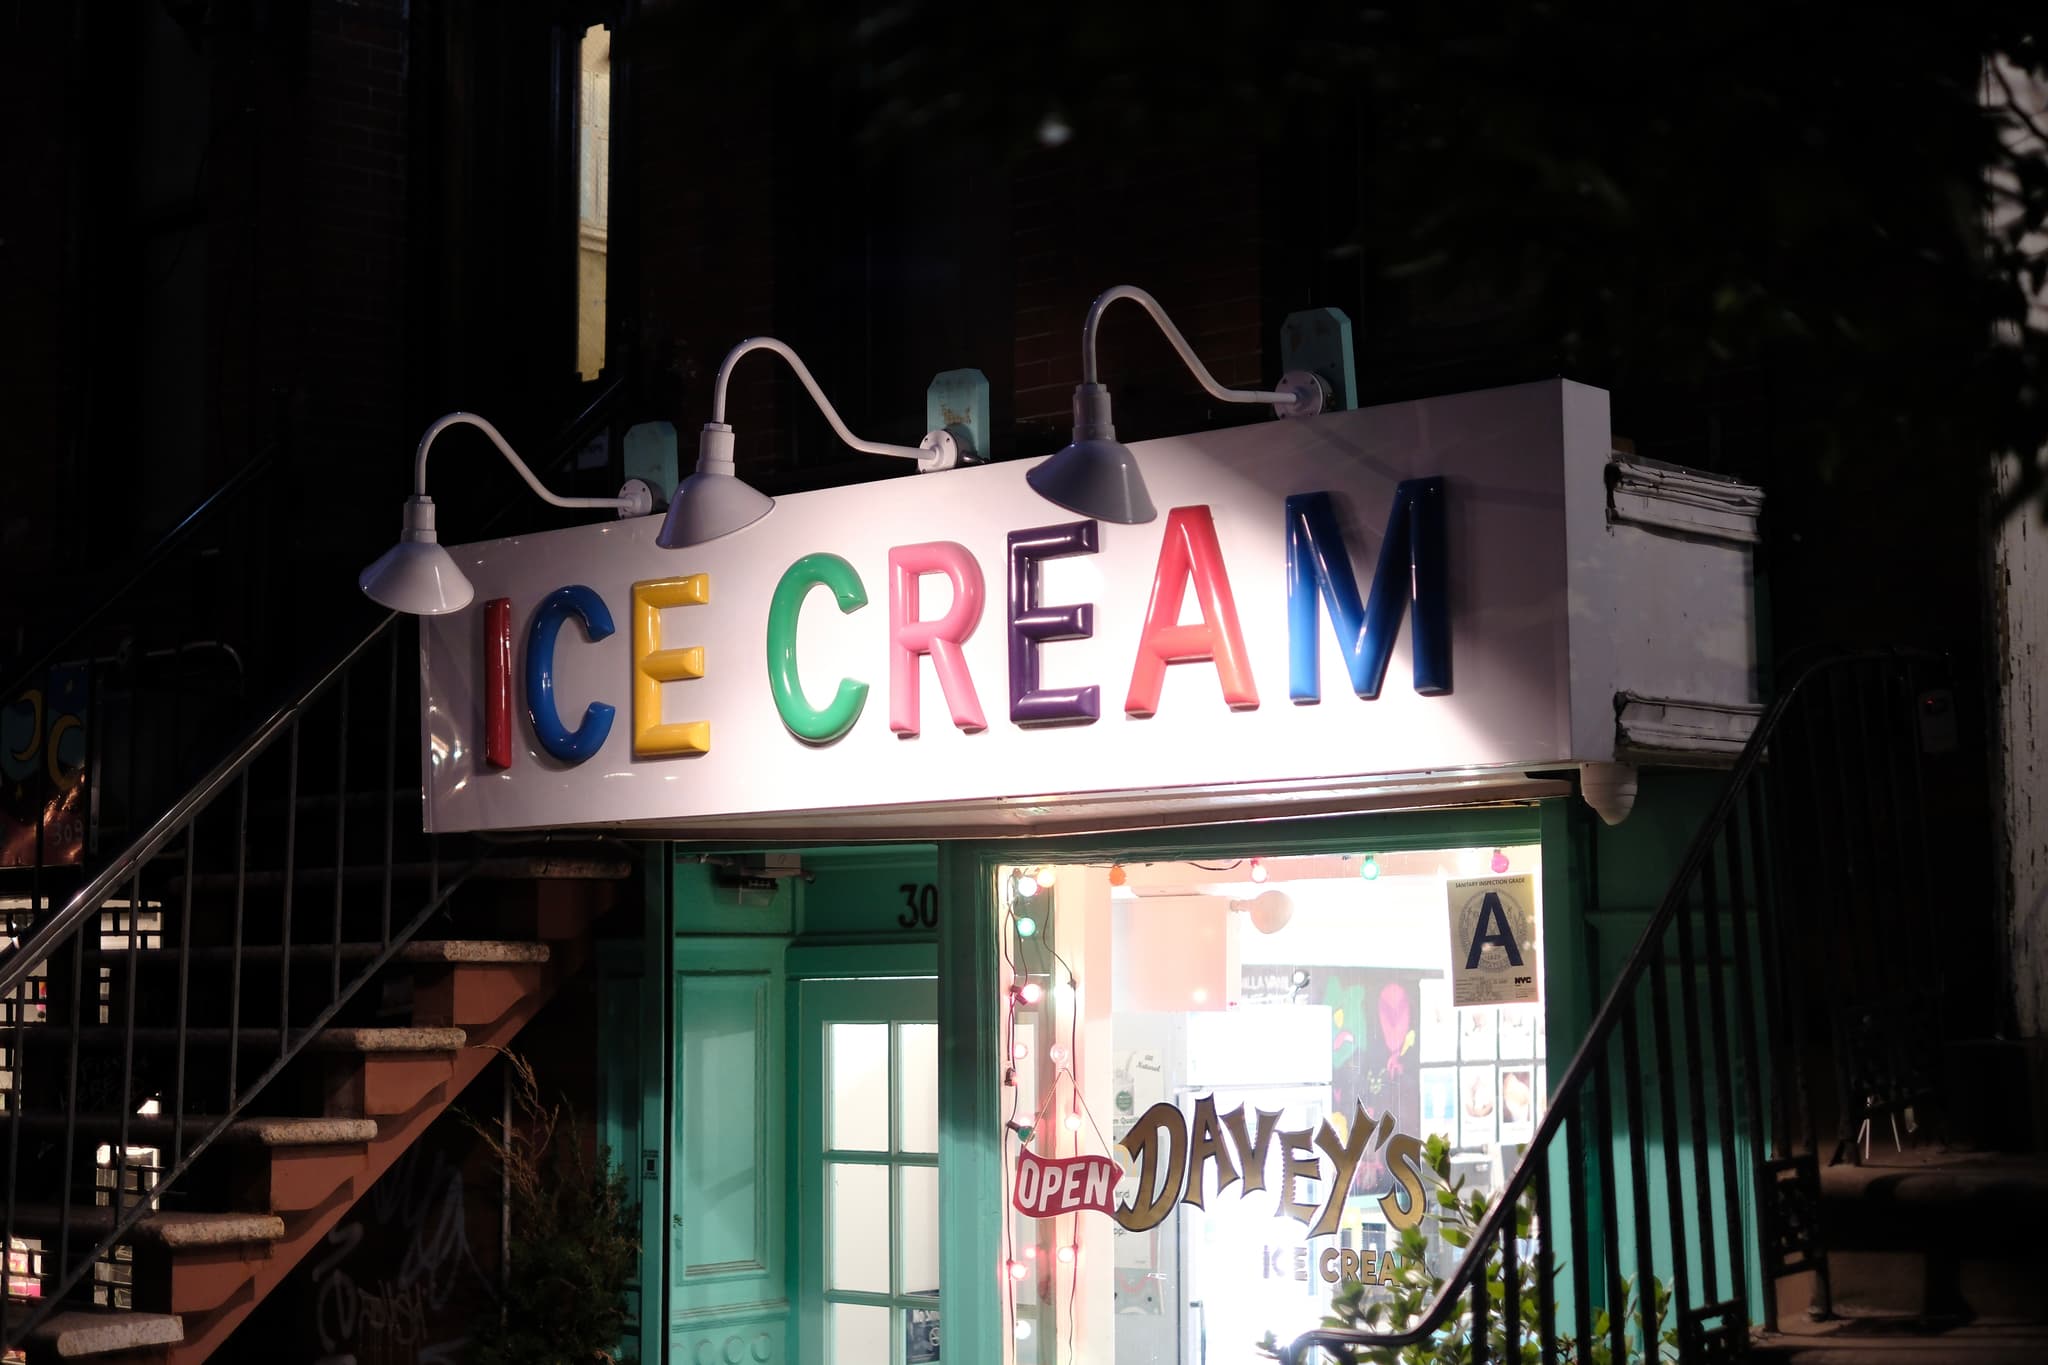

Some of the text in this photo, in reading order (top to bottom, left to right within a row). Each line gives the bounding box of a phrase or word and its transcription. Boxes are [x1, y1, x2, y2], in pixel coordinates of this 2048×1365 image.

[485, 476, 1453, 769] ICE CREAM
[1479, 879, 1508, 887] INSPECTION
[1465, 892, 1523, 969] A
[1514, 976, 1531, 984] NYC
[1018, 1159, 1110, 1211] OPEN
[1114, 1093, 1427, 1240] DAVEY'S
[1263, 1244, 1426, 1287] ICE CREA
